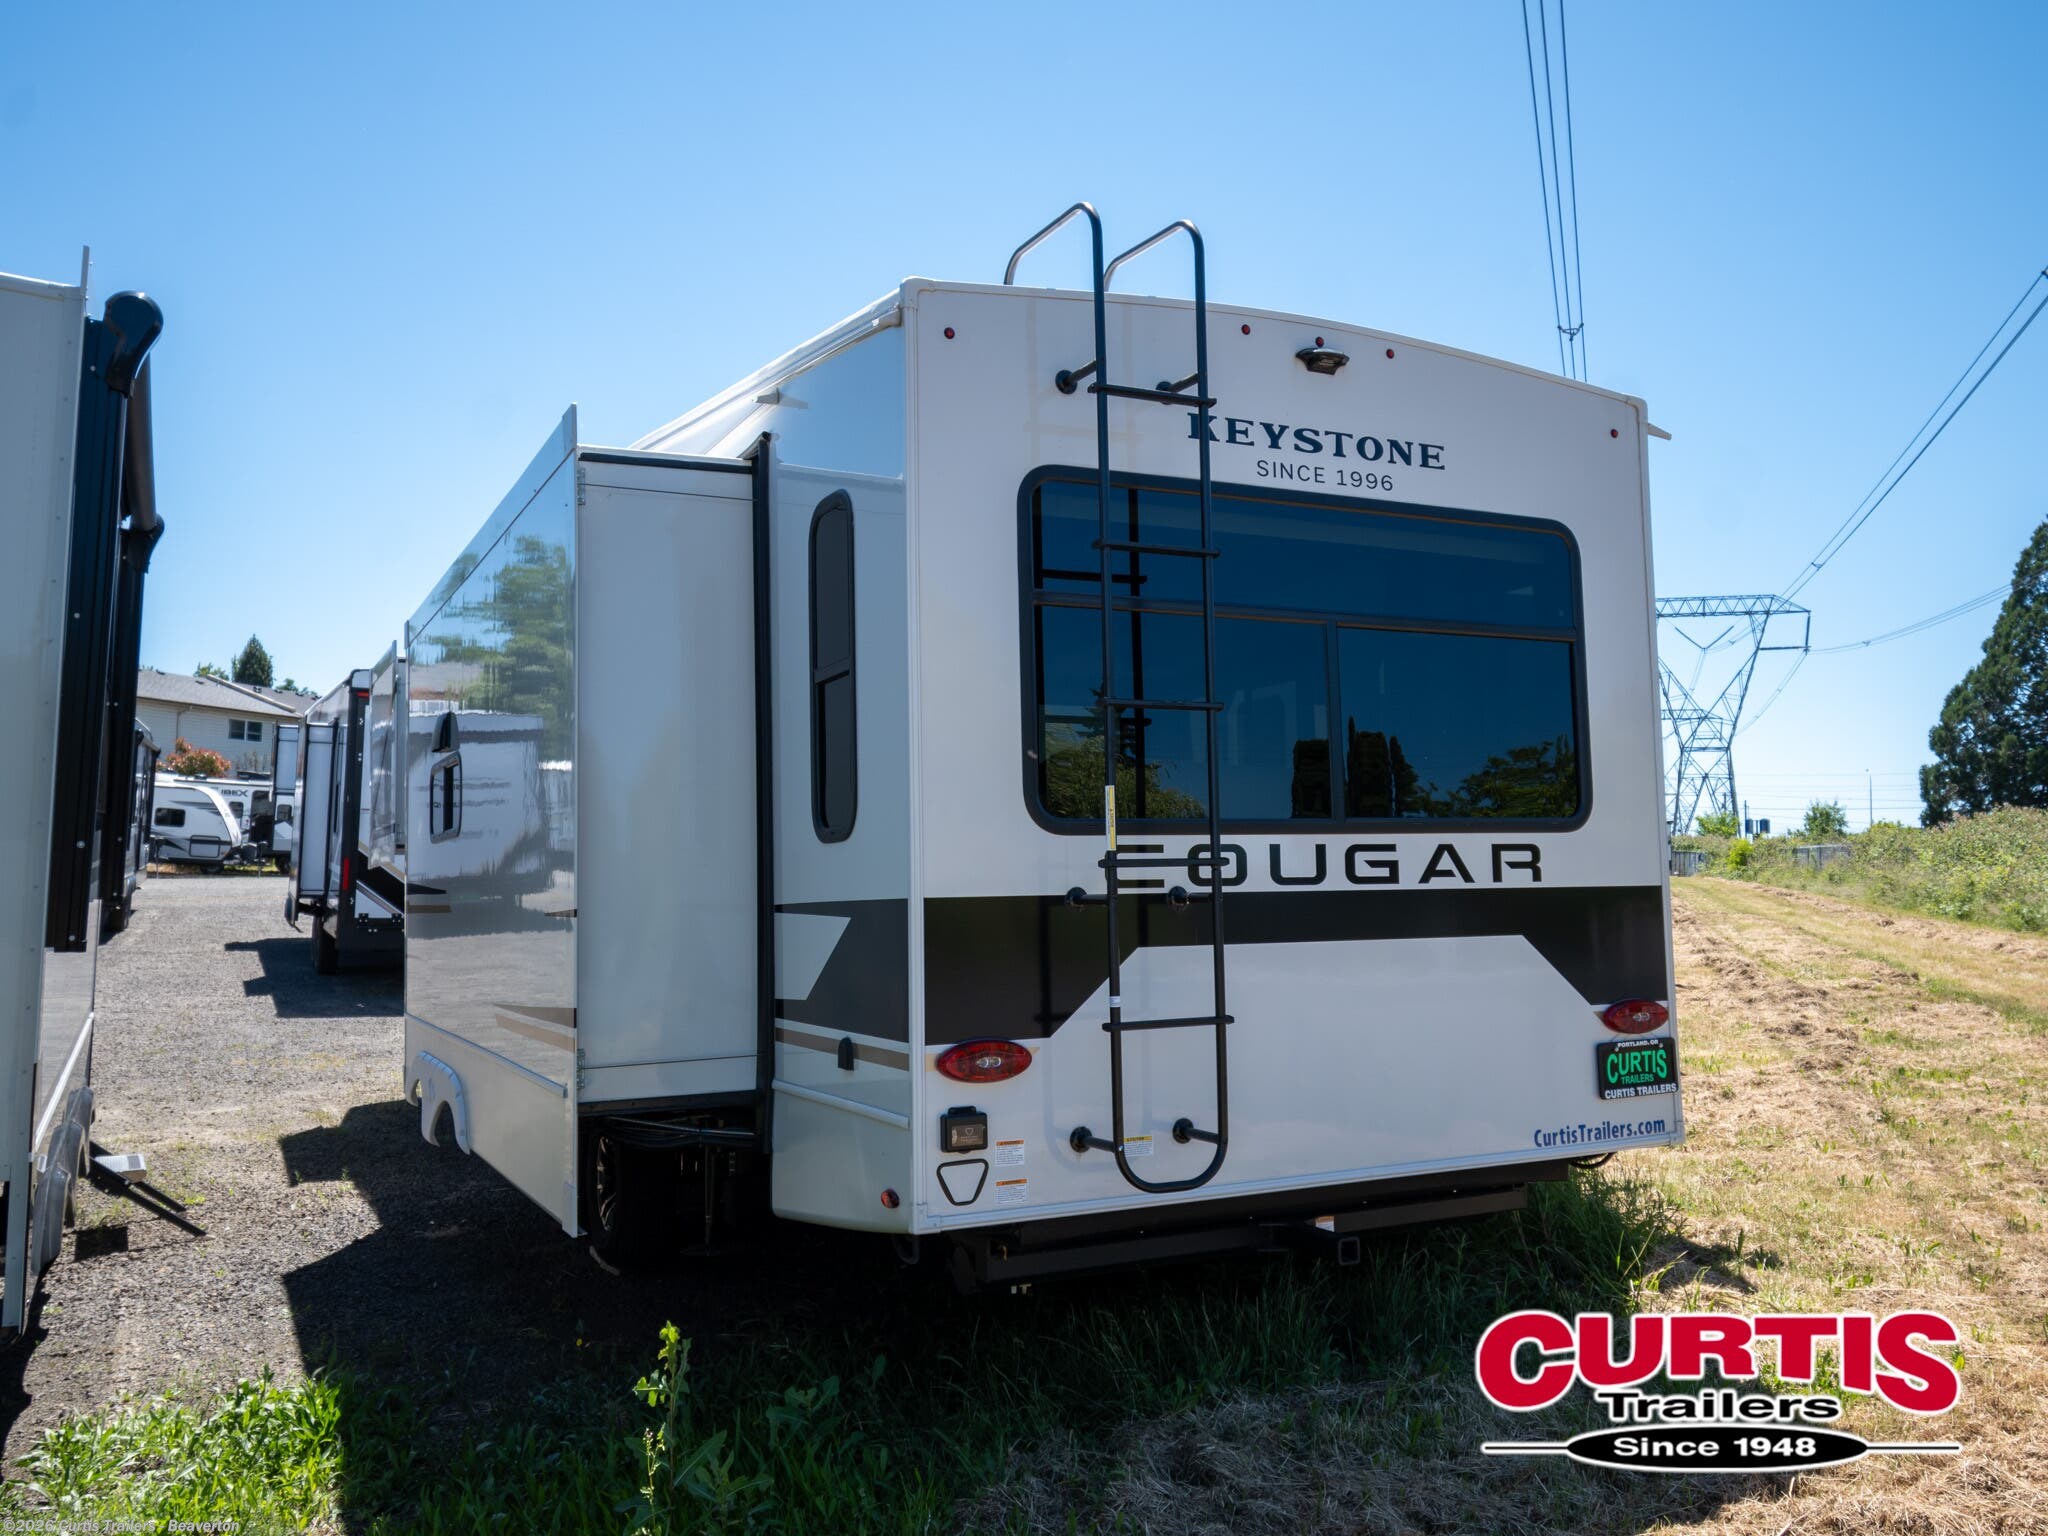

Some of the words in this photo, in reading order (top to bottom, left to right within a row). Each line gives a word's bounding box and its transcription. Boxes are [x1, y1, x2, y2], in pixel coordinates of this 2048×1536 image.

[1187, 412, 1446, 470] KEYSTONE
[1256, 459, 1325, 484] SINCE
[1336, 469, 1394, 492] 1996
[1105, 843, 1542, 889] COUGAR
[1606, 1049, 1667, 1084] CURTIS
[1621, 1073, 1655, 1085] TRAILERS
[1605, 1087, 1636, 1099] CURTIS
[1636, 1083, 1677, 1096] TRAILERS
[1533, 1118, 1666, 1148] CurtisTrailers.com
